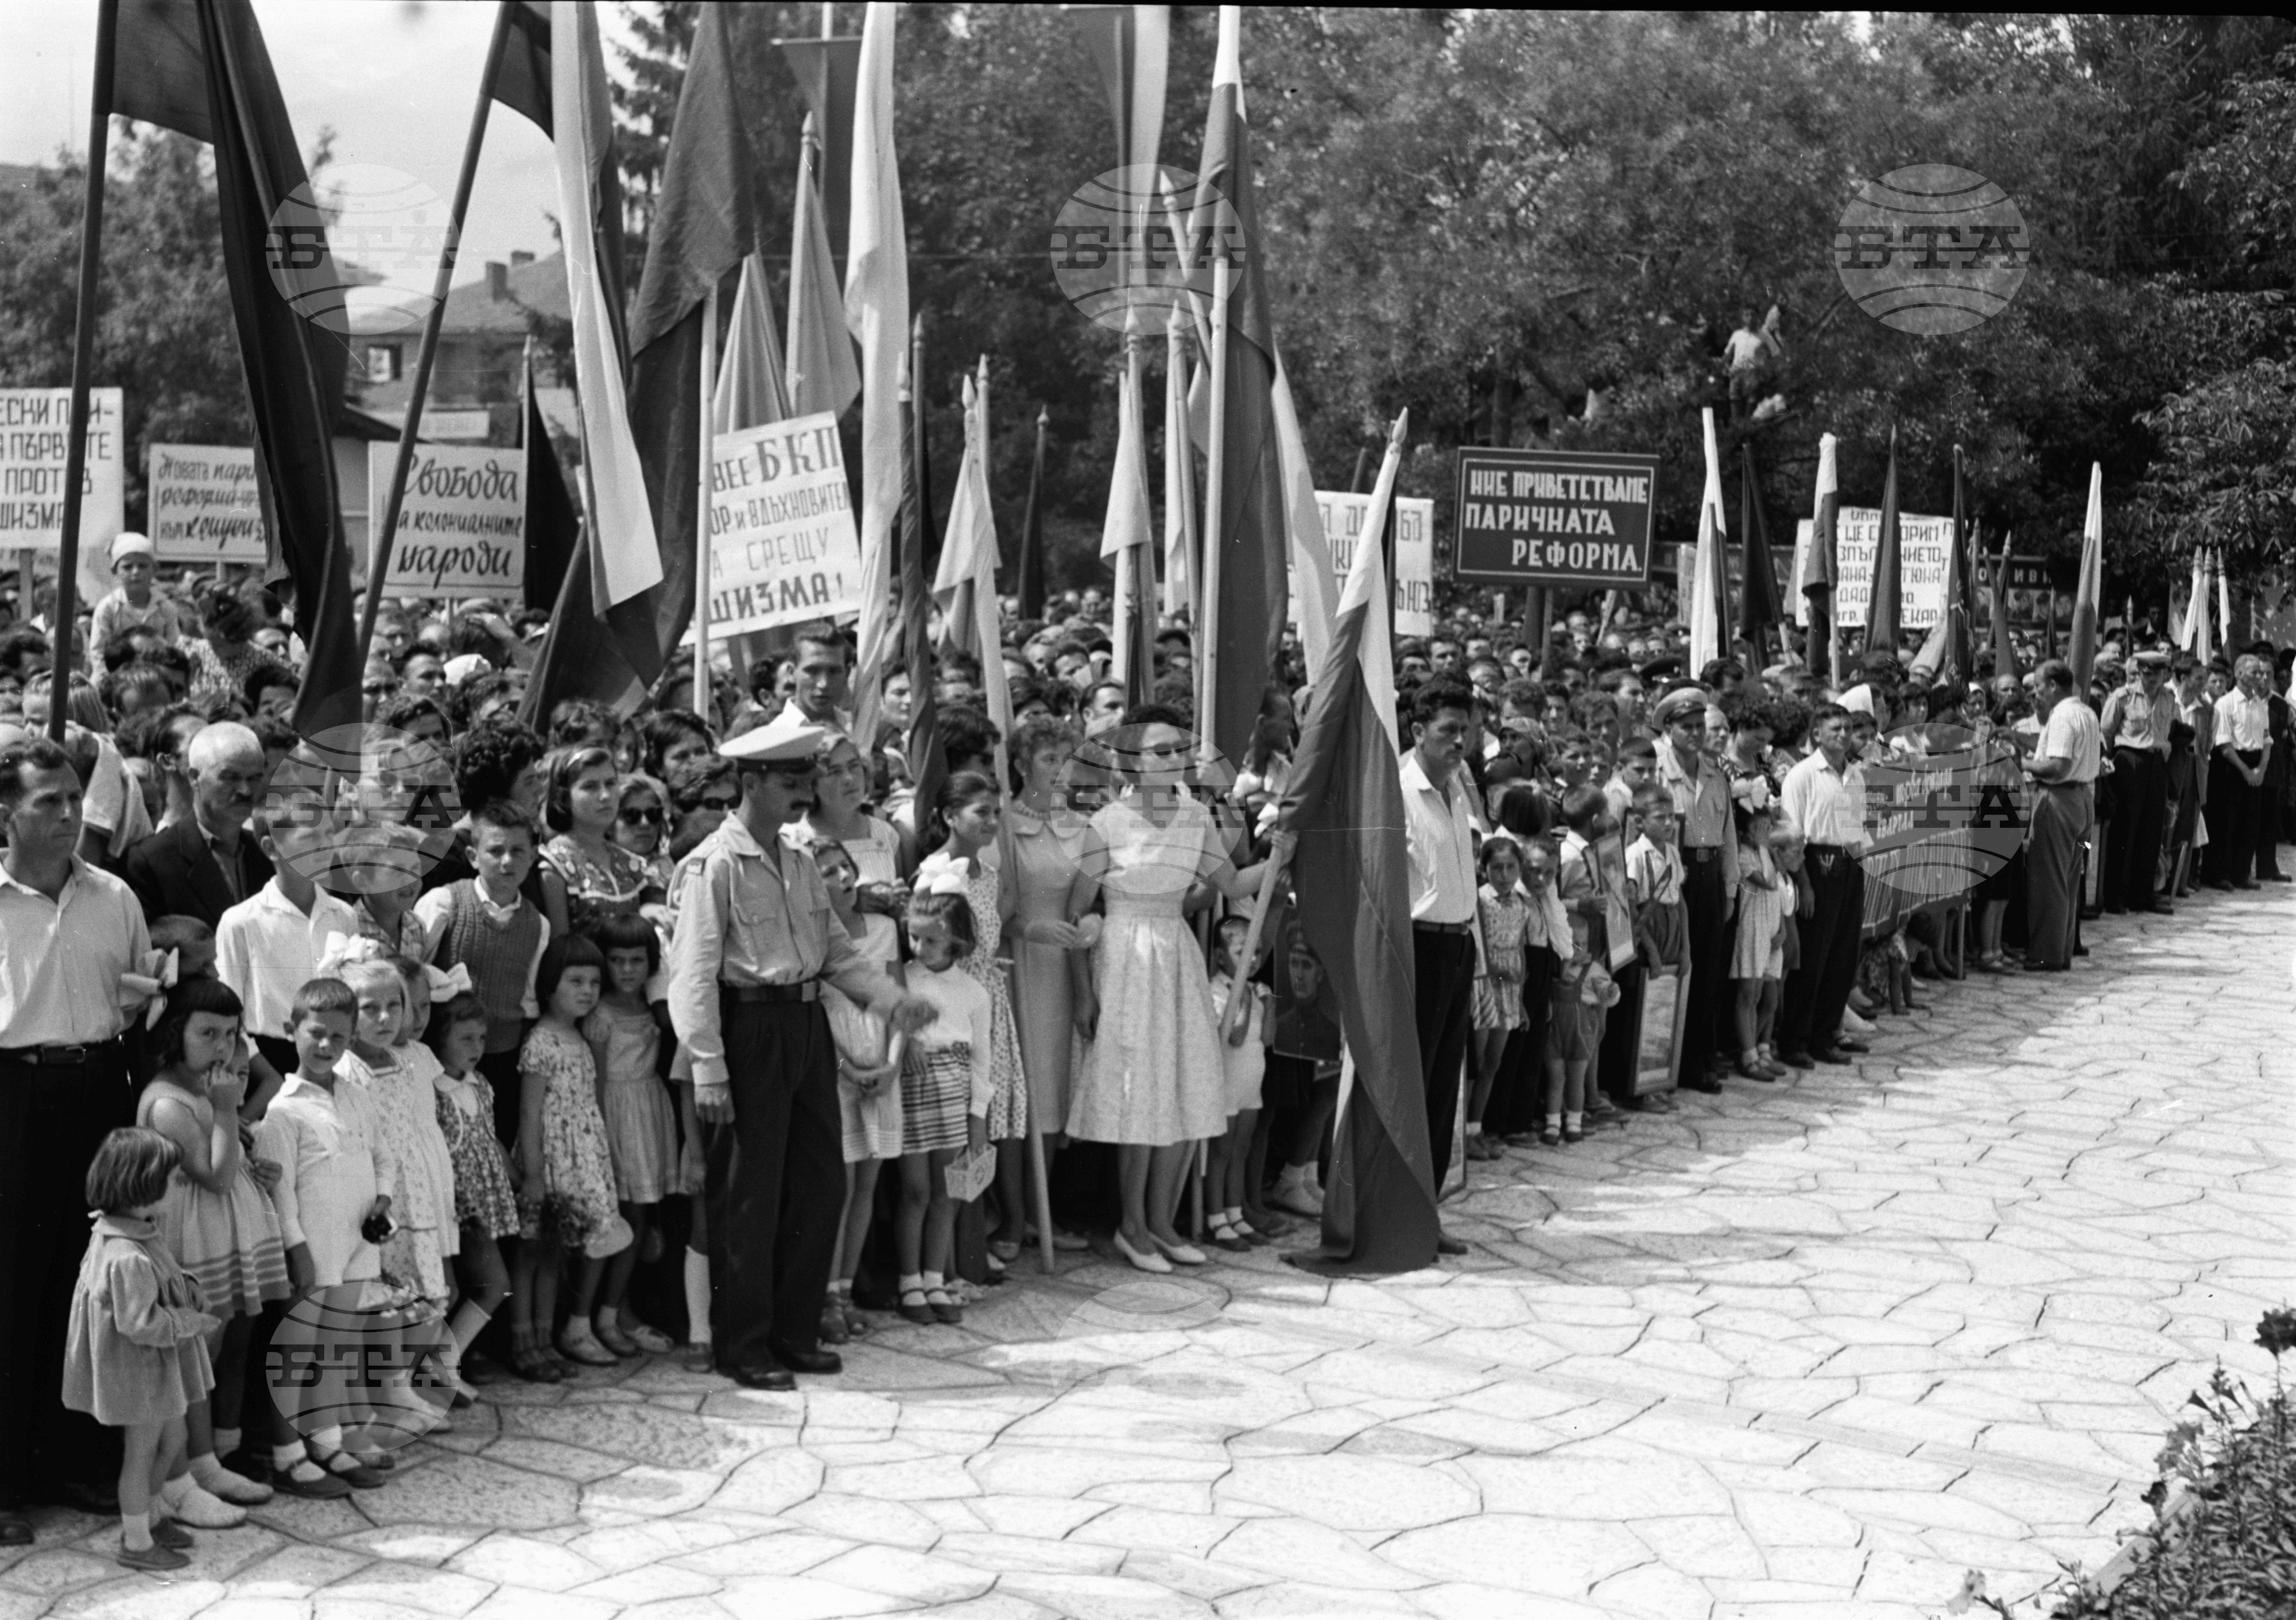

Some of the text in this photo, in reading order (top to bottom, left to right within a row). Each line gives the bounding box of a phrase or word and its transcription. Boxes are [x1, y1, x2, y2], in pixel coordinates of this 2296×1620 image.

[10, 432, 113, 460] ПЪРВТЕ
[755, 426, 840, 482] БКП
[5, 467, 93, 495] ПРОТВ
[1470, 469, 1508, 497] НИЕ
[1464, 502, 1616, 536] ПАРИЧНАТА
[1845, 525, 1864, 542] ЩЕ
[746, 527, 829, 571] СРЕЩУ
[1511, 538, 1643, 572] РЕФОРМА.
[398, 540, 511, 590] народи
[1838, 565, 1867, 582] АНА
